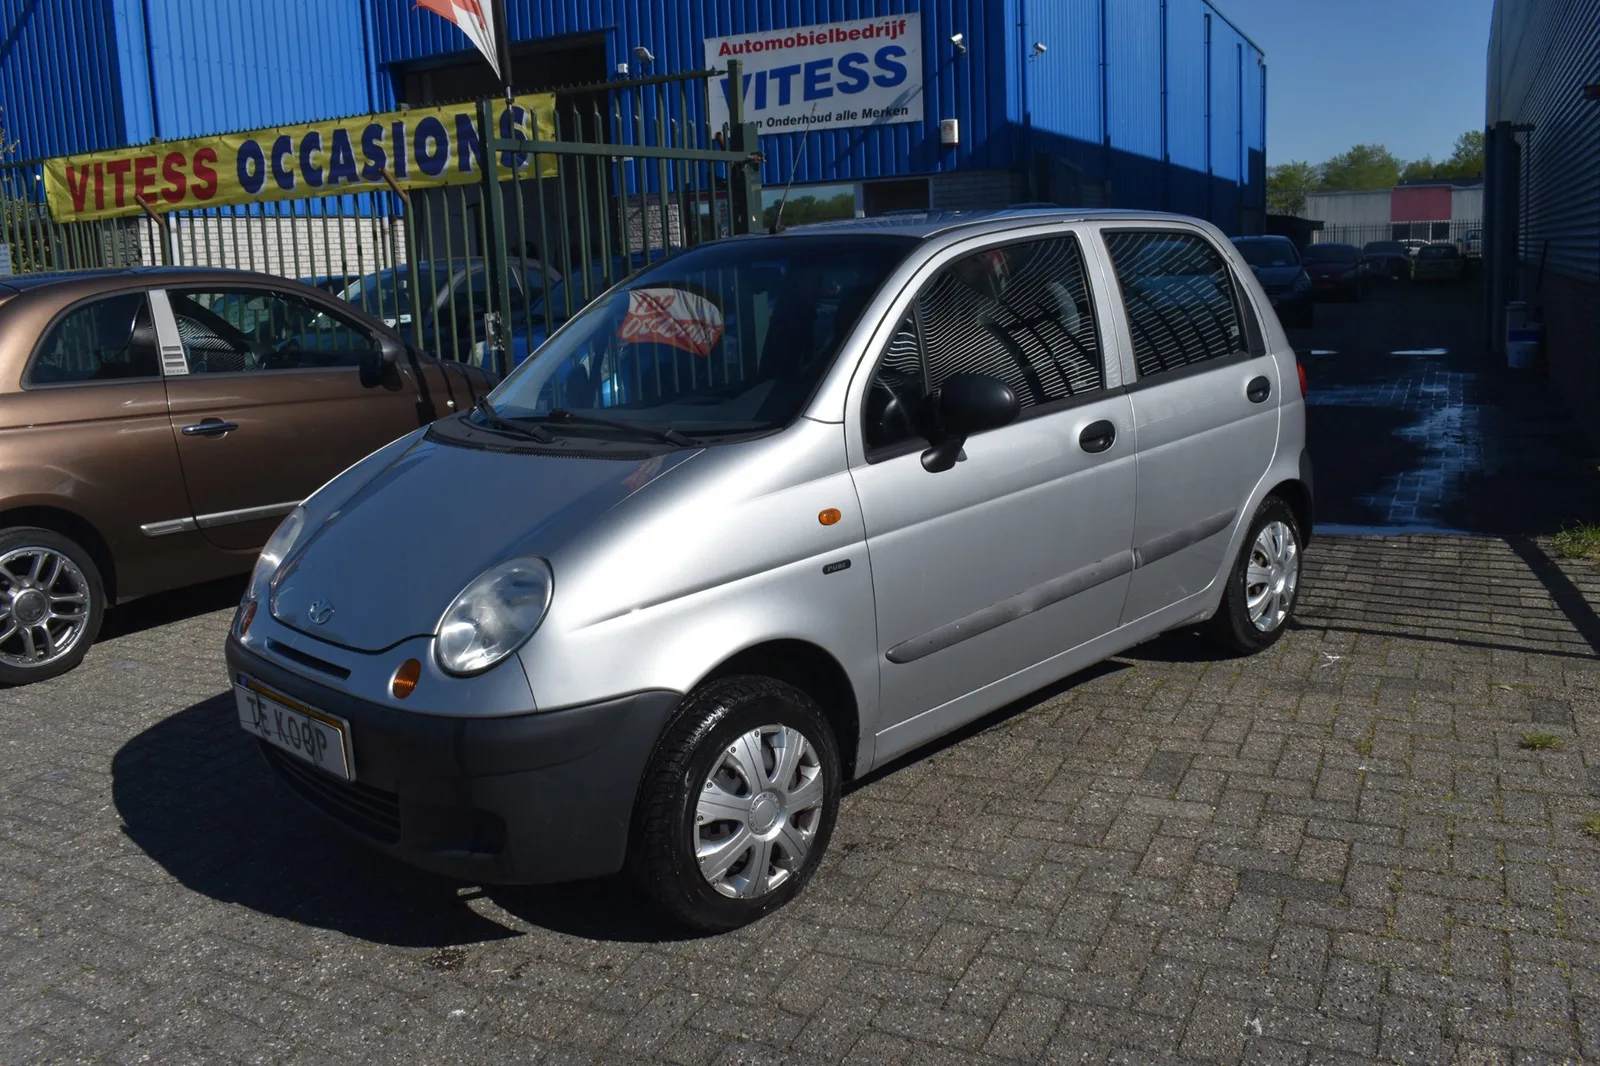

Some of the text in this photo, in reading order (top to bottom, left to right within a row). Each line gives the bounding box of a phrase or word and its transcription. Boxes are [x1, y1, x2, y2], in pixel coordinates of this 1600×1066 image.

[718, 19, 906, 56] Automobielbedrijf
[720, 45, 908, 113] VITESS
[766, 111, 832, 128] Onderhoud
[835, 109, 858, 121] alle
[862, 105, 909, 119] Merken
[65, 105, 530, 213] VITESS OCCASIONS
[246, 695, 327, 762] TE KOOP
